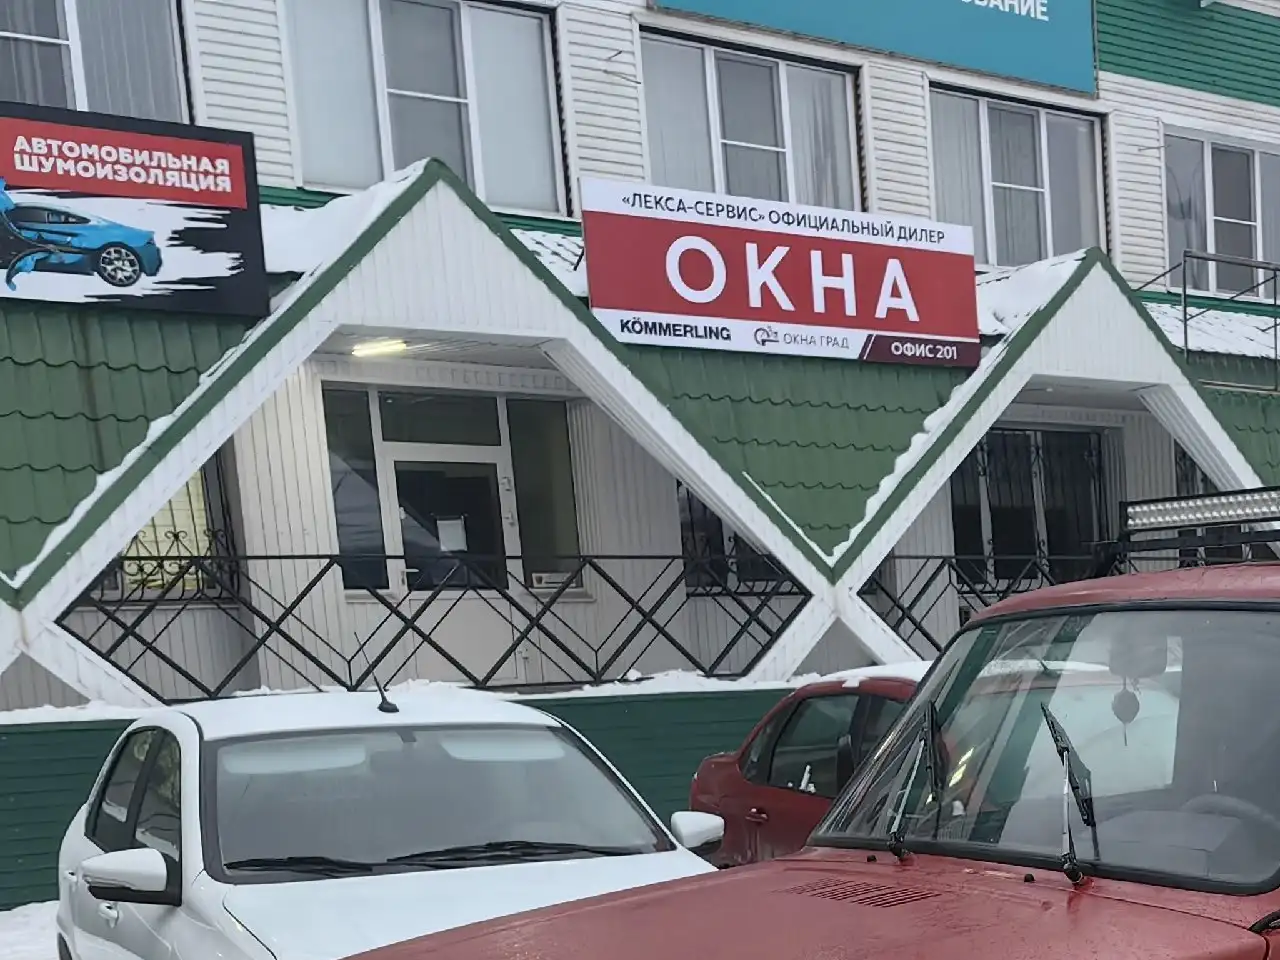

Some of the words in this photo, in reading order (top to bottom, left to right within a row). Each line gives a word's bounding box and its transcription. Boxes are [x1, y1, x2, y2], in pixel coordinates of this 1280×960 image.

[14, 136, 230, 175] АВТОМОБИЛЬНАЯ
[14, 154, 232, 192] ШУМОИЗОЛЯЦИЯ
[622, 192, 765, 222] «ЛЕКСА-СЕРВИС»
[768, 209, 895, 240] ОФИЦИАЛЬНЫЙ
[897, 224, 945, 245] ДИЛЕР
[665, 235, 920, 322] ОКНА
[620, 317, 732, 341] KÖMMERLING
[782, 331, 817, 347] ОКНА
[820, 335, 850, 349] ГРАД
[890, 341, 934, 359] ОФИС
[936, 345, 958, 361] 201
